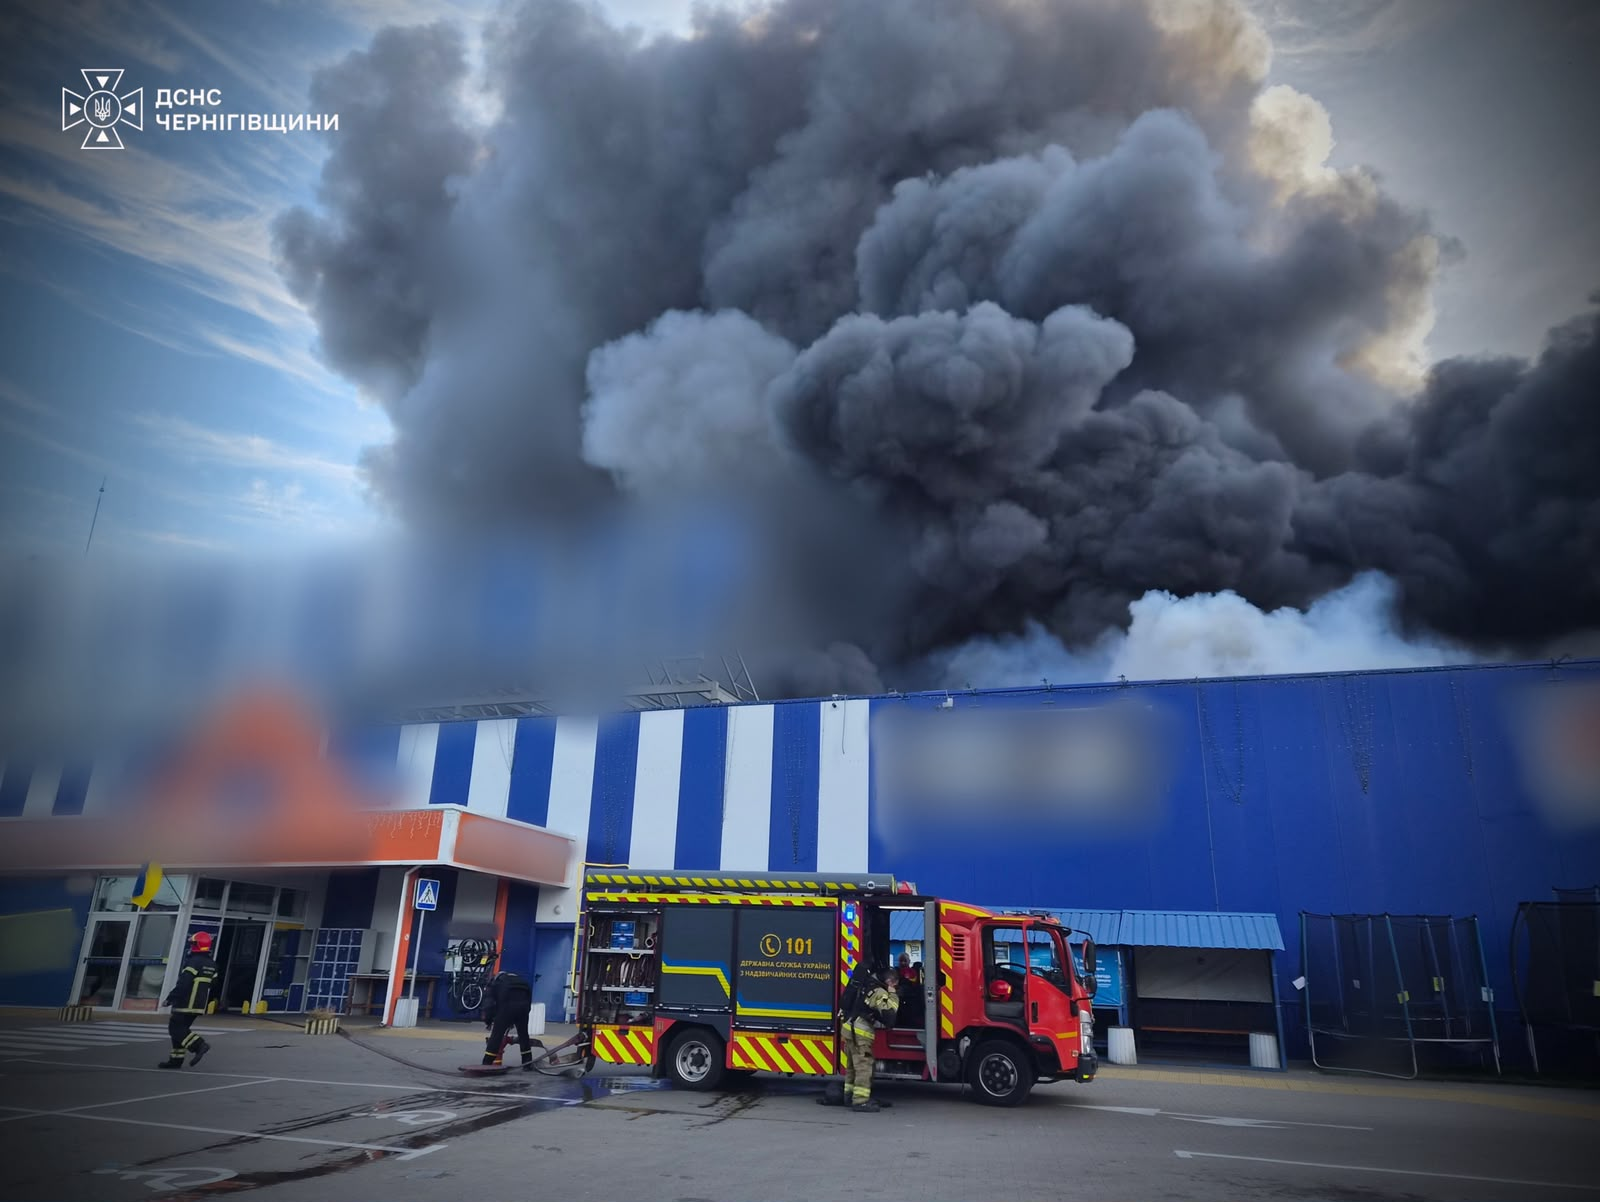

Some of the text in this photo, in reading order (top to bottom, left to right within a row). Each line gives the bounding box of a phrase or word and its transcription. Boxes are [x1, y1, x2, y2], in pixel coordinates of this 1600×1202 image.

[786, 938, 812, 955] 101
[803, 962, 831, 970] УКРАЇНИ
[745, 970, 797, 978] НАДЗВИЧАЙНИХ
[798, 972, 831, 980] СИТУАЦІЙ
